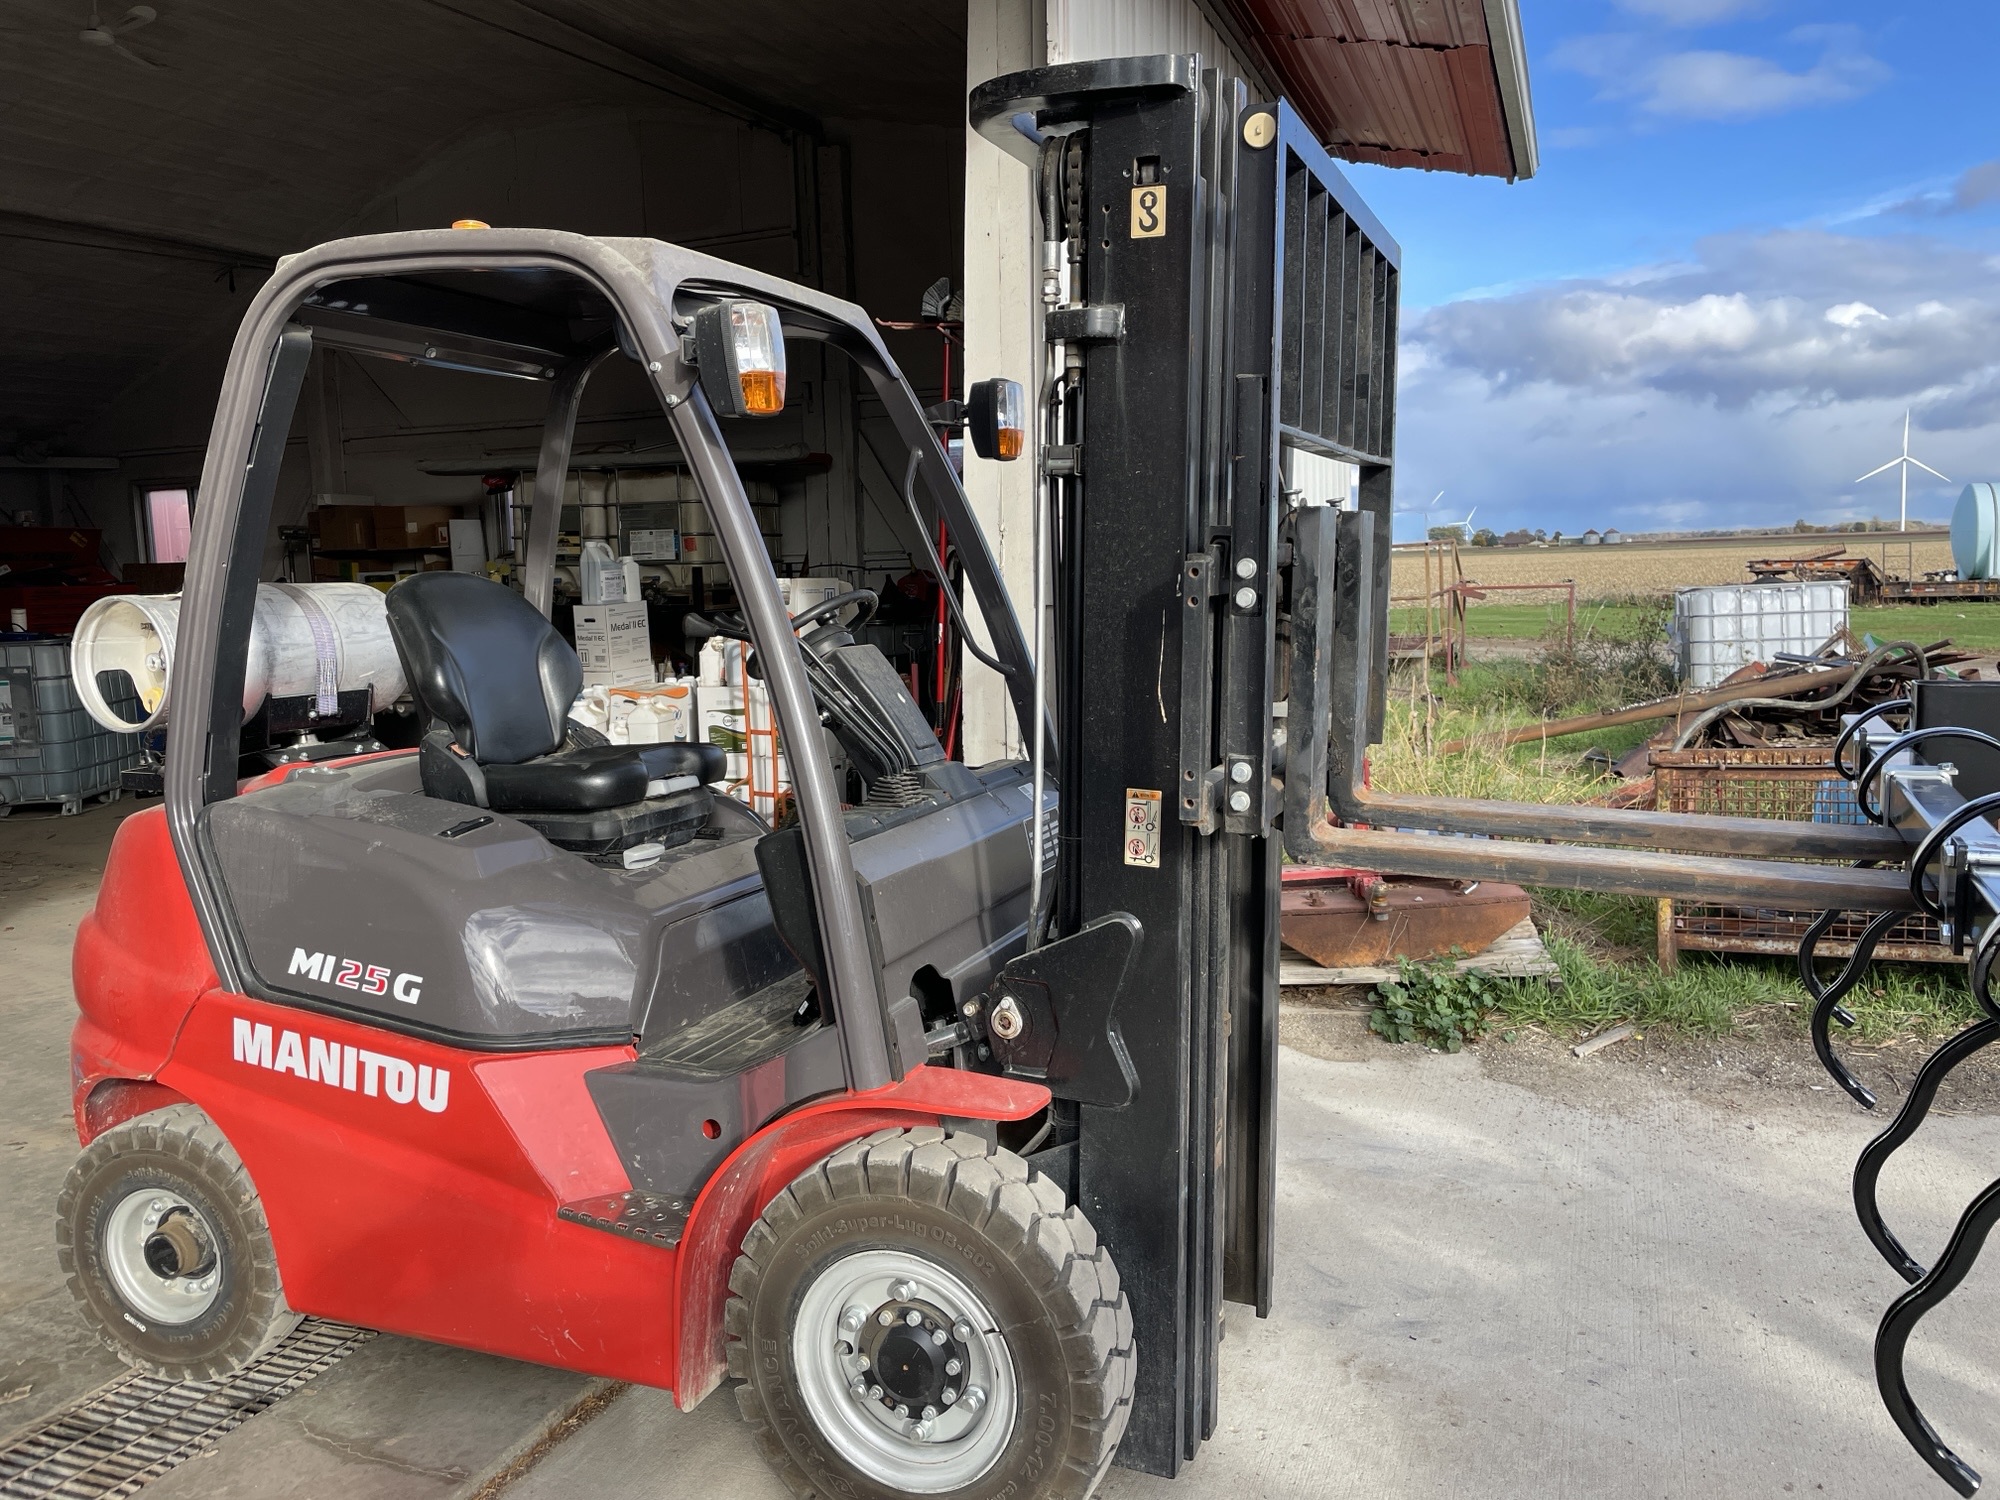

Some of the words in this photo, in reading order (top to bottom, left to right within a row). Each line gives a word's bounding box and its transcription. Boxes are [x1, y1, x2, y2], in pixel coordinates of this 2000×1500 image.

[610, 621, 632, 632] Medal
[637, 619, 646, 628] EC
[233, 1017, 451, 1113] MANITOU
[761, 1339, 825, 1464] ADVANCE
[1020, 1392, 1058, 1482] 7.00-12
